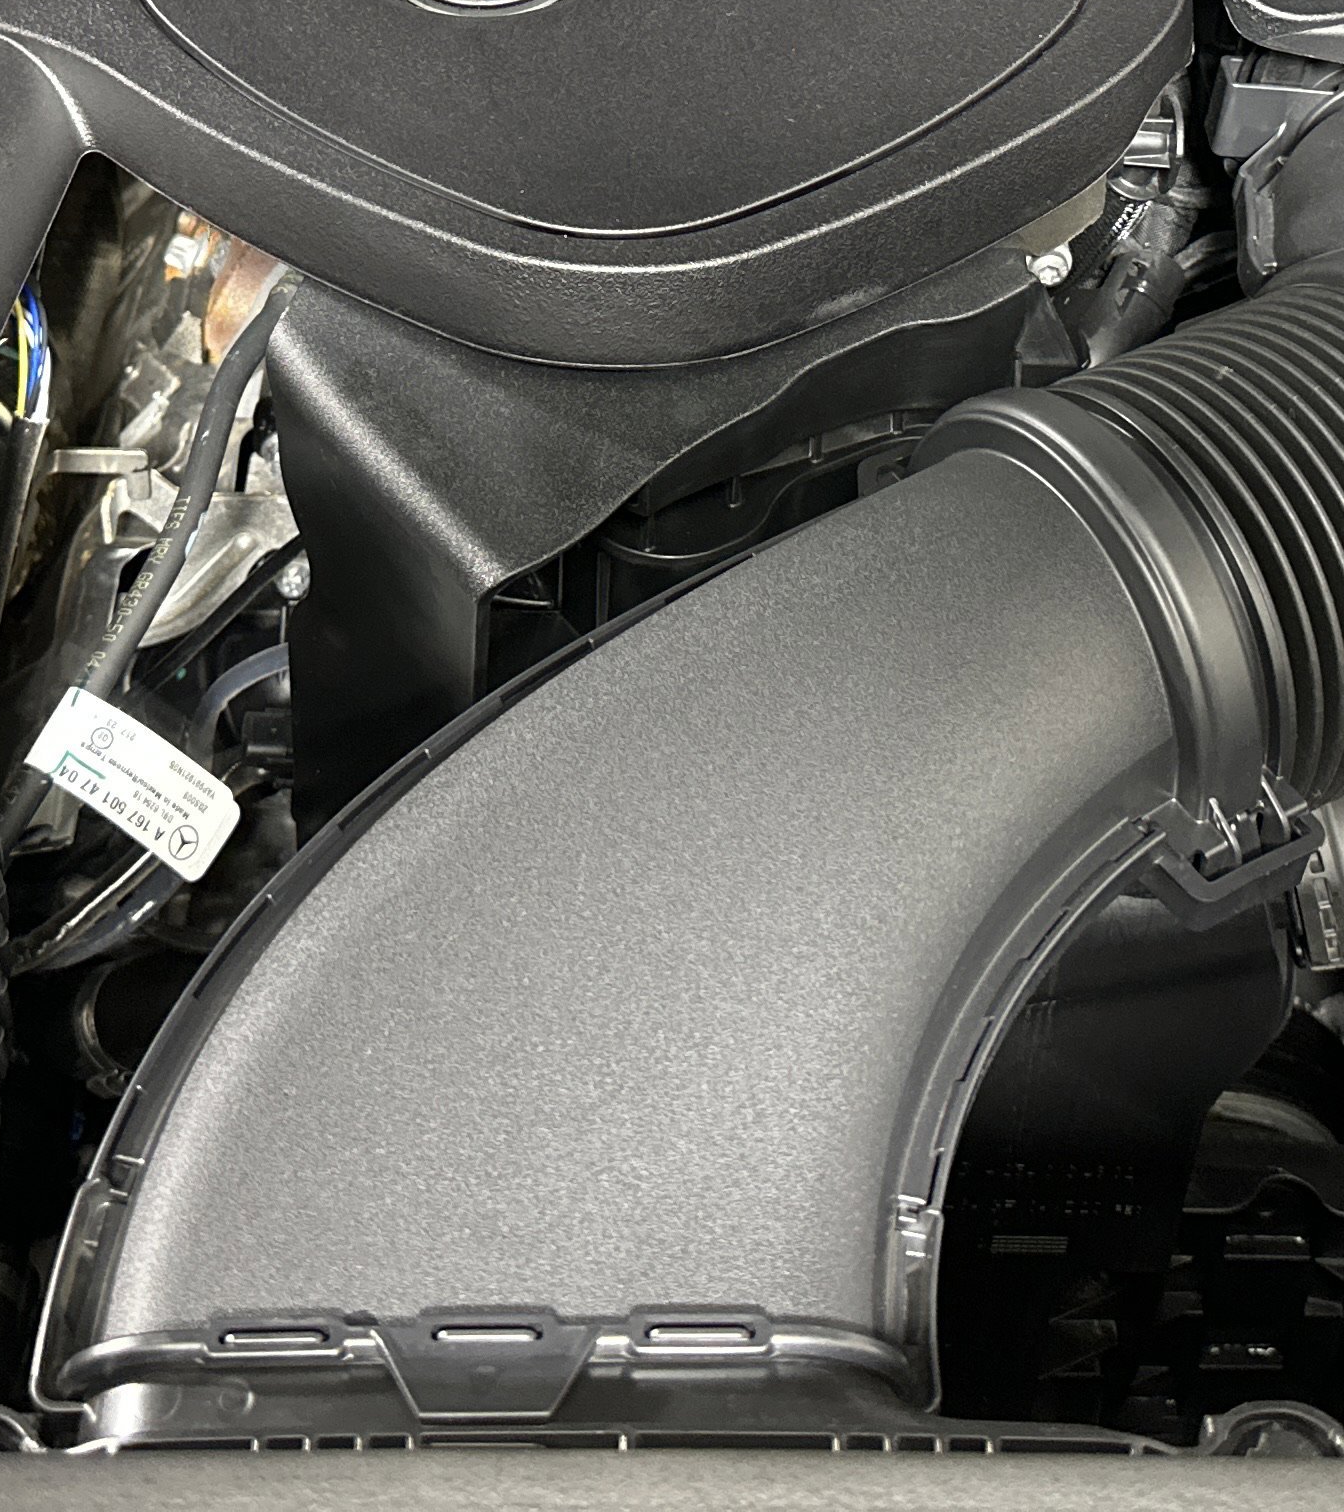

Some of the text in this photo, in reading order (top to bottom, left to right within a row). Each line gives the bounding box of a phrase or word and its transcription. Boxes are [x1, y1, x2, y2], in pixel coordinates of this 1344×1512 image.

[58, 765, 166, 841] A 167 501 47 04
[171, 803, 190, 820] Made
